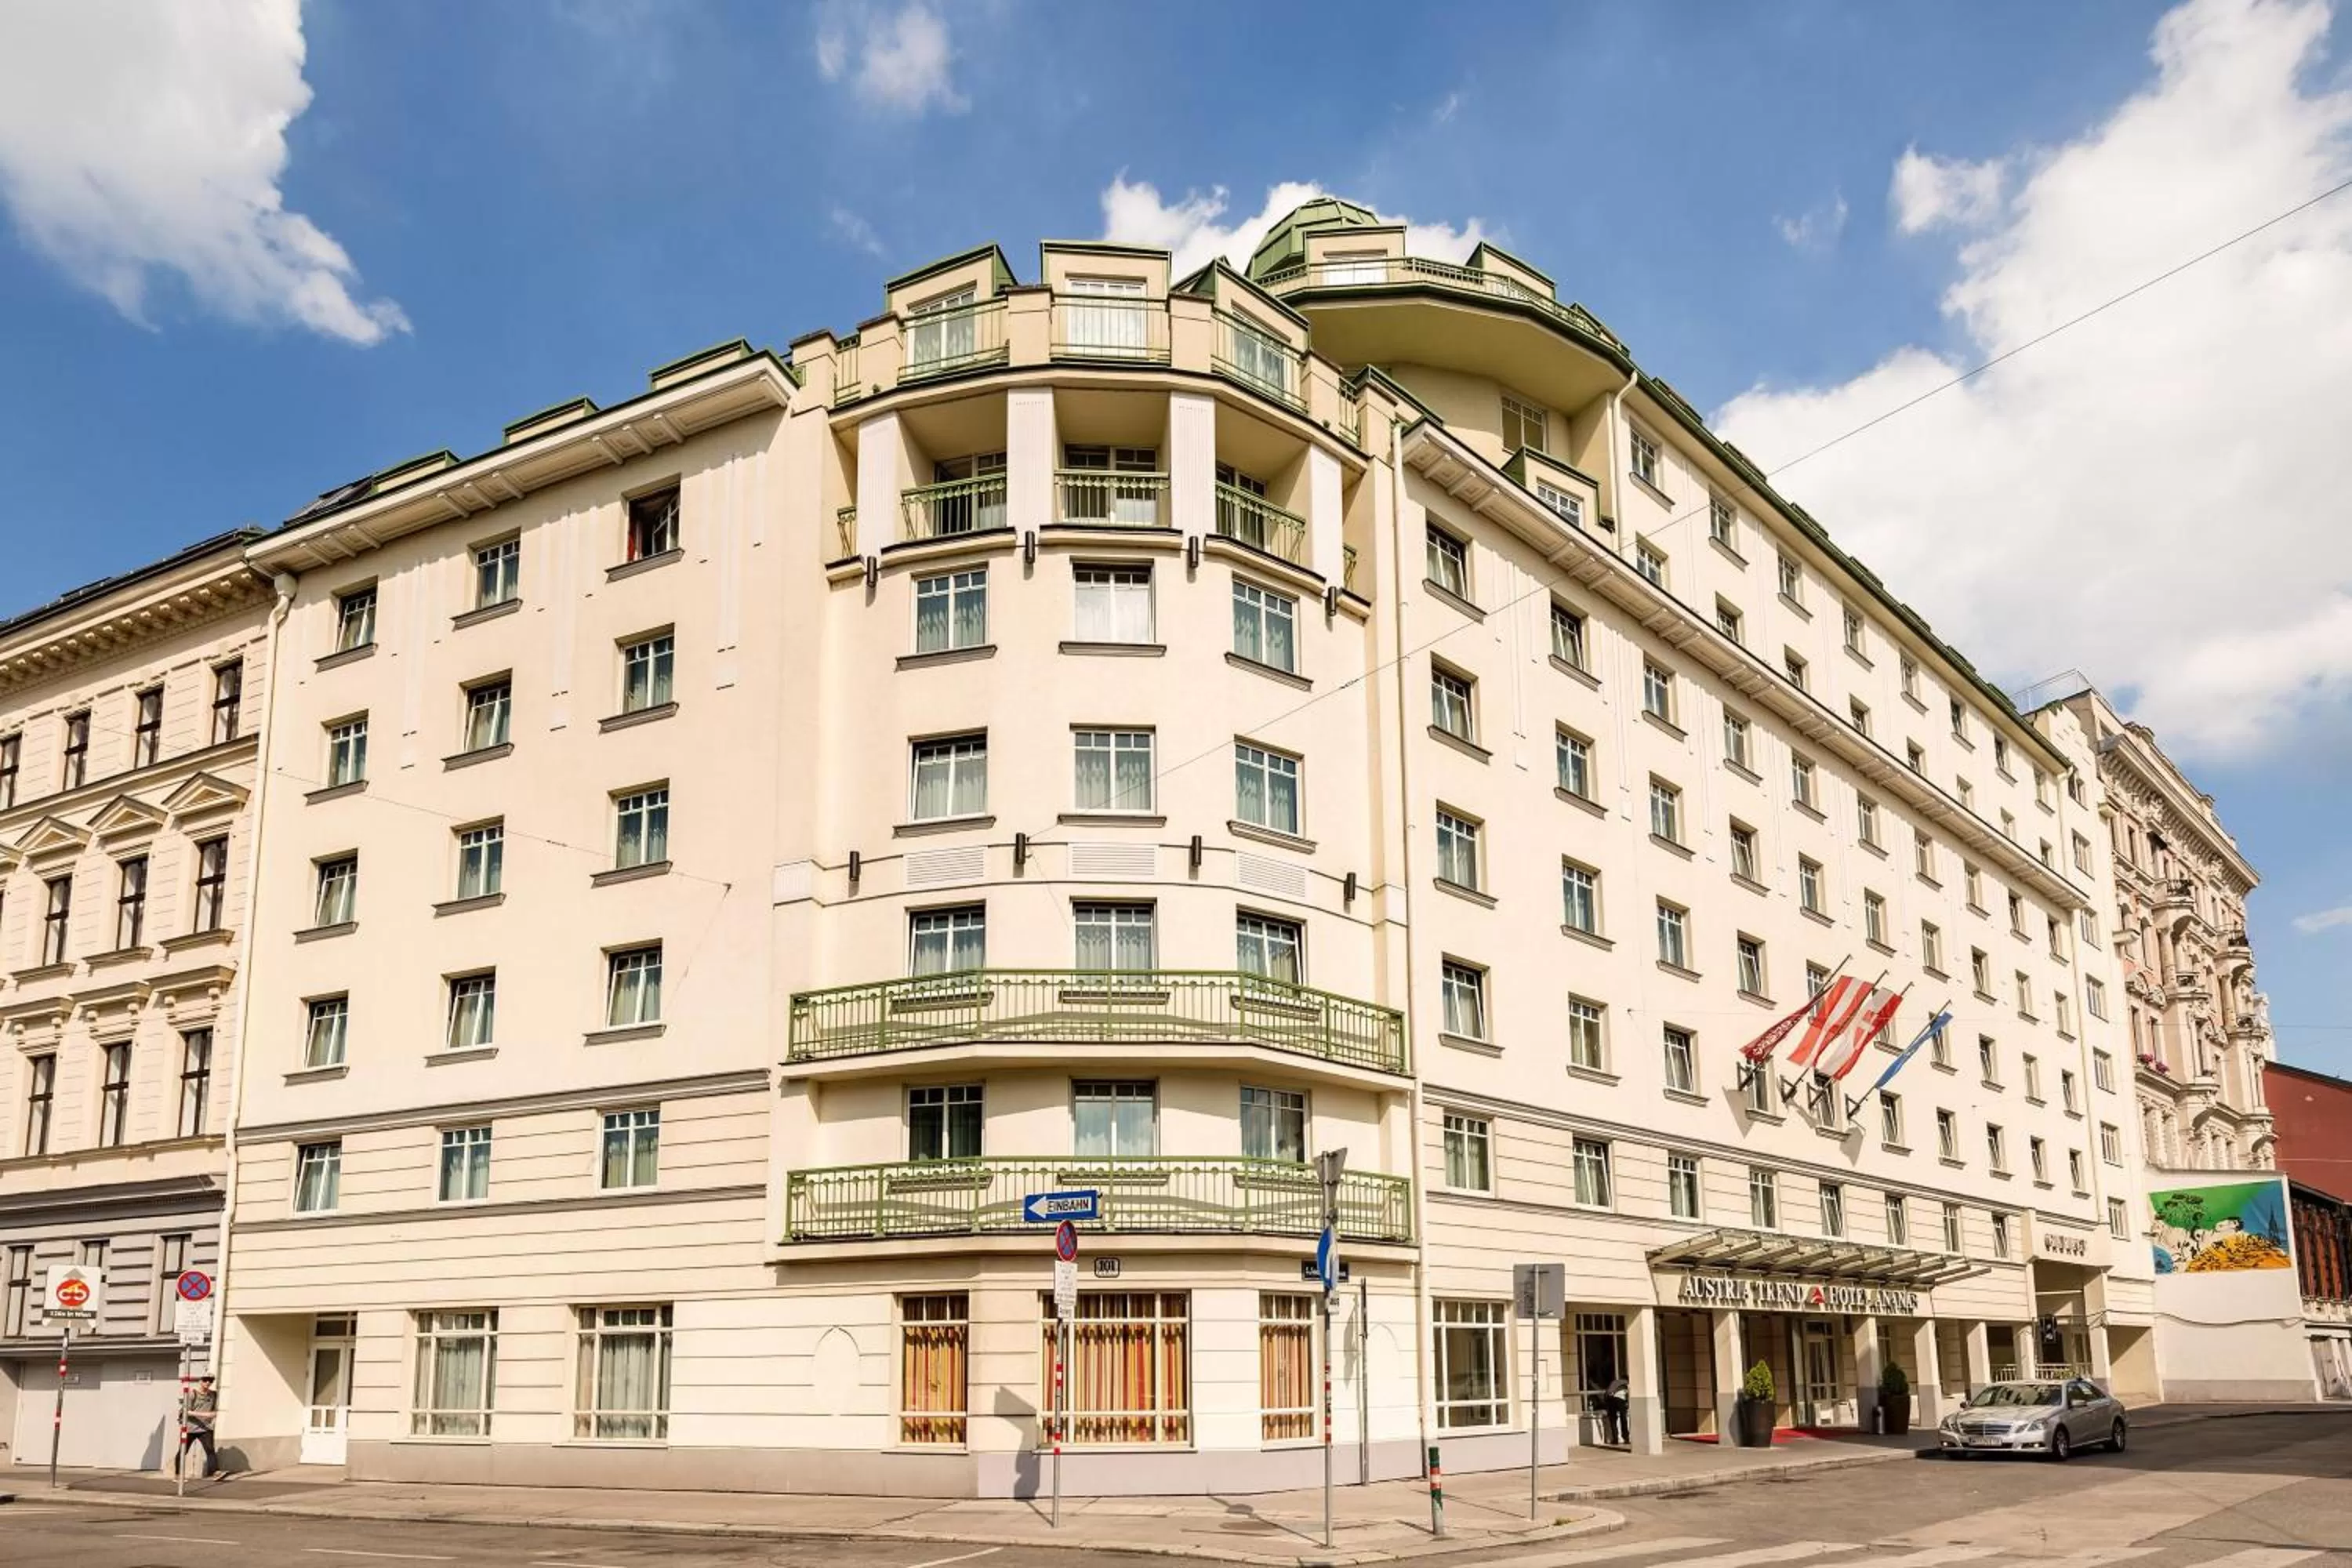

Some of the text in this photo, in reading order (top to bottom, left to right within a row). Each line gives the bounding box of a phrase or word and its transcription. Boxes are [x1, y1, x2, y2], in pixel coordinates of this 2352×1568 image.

[1047, 1198, 1090, 1213] EINBAHN
[1098, 1260, 1116, 1272] 101
[1685, 1274, 1752, 1299] AUSTRIA
[1756, 1280, 1805, 1303] TREND
